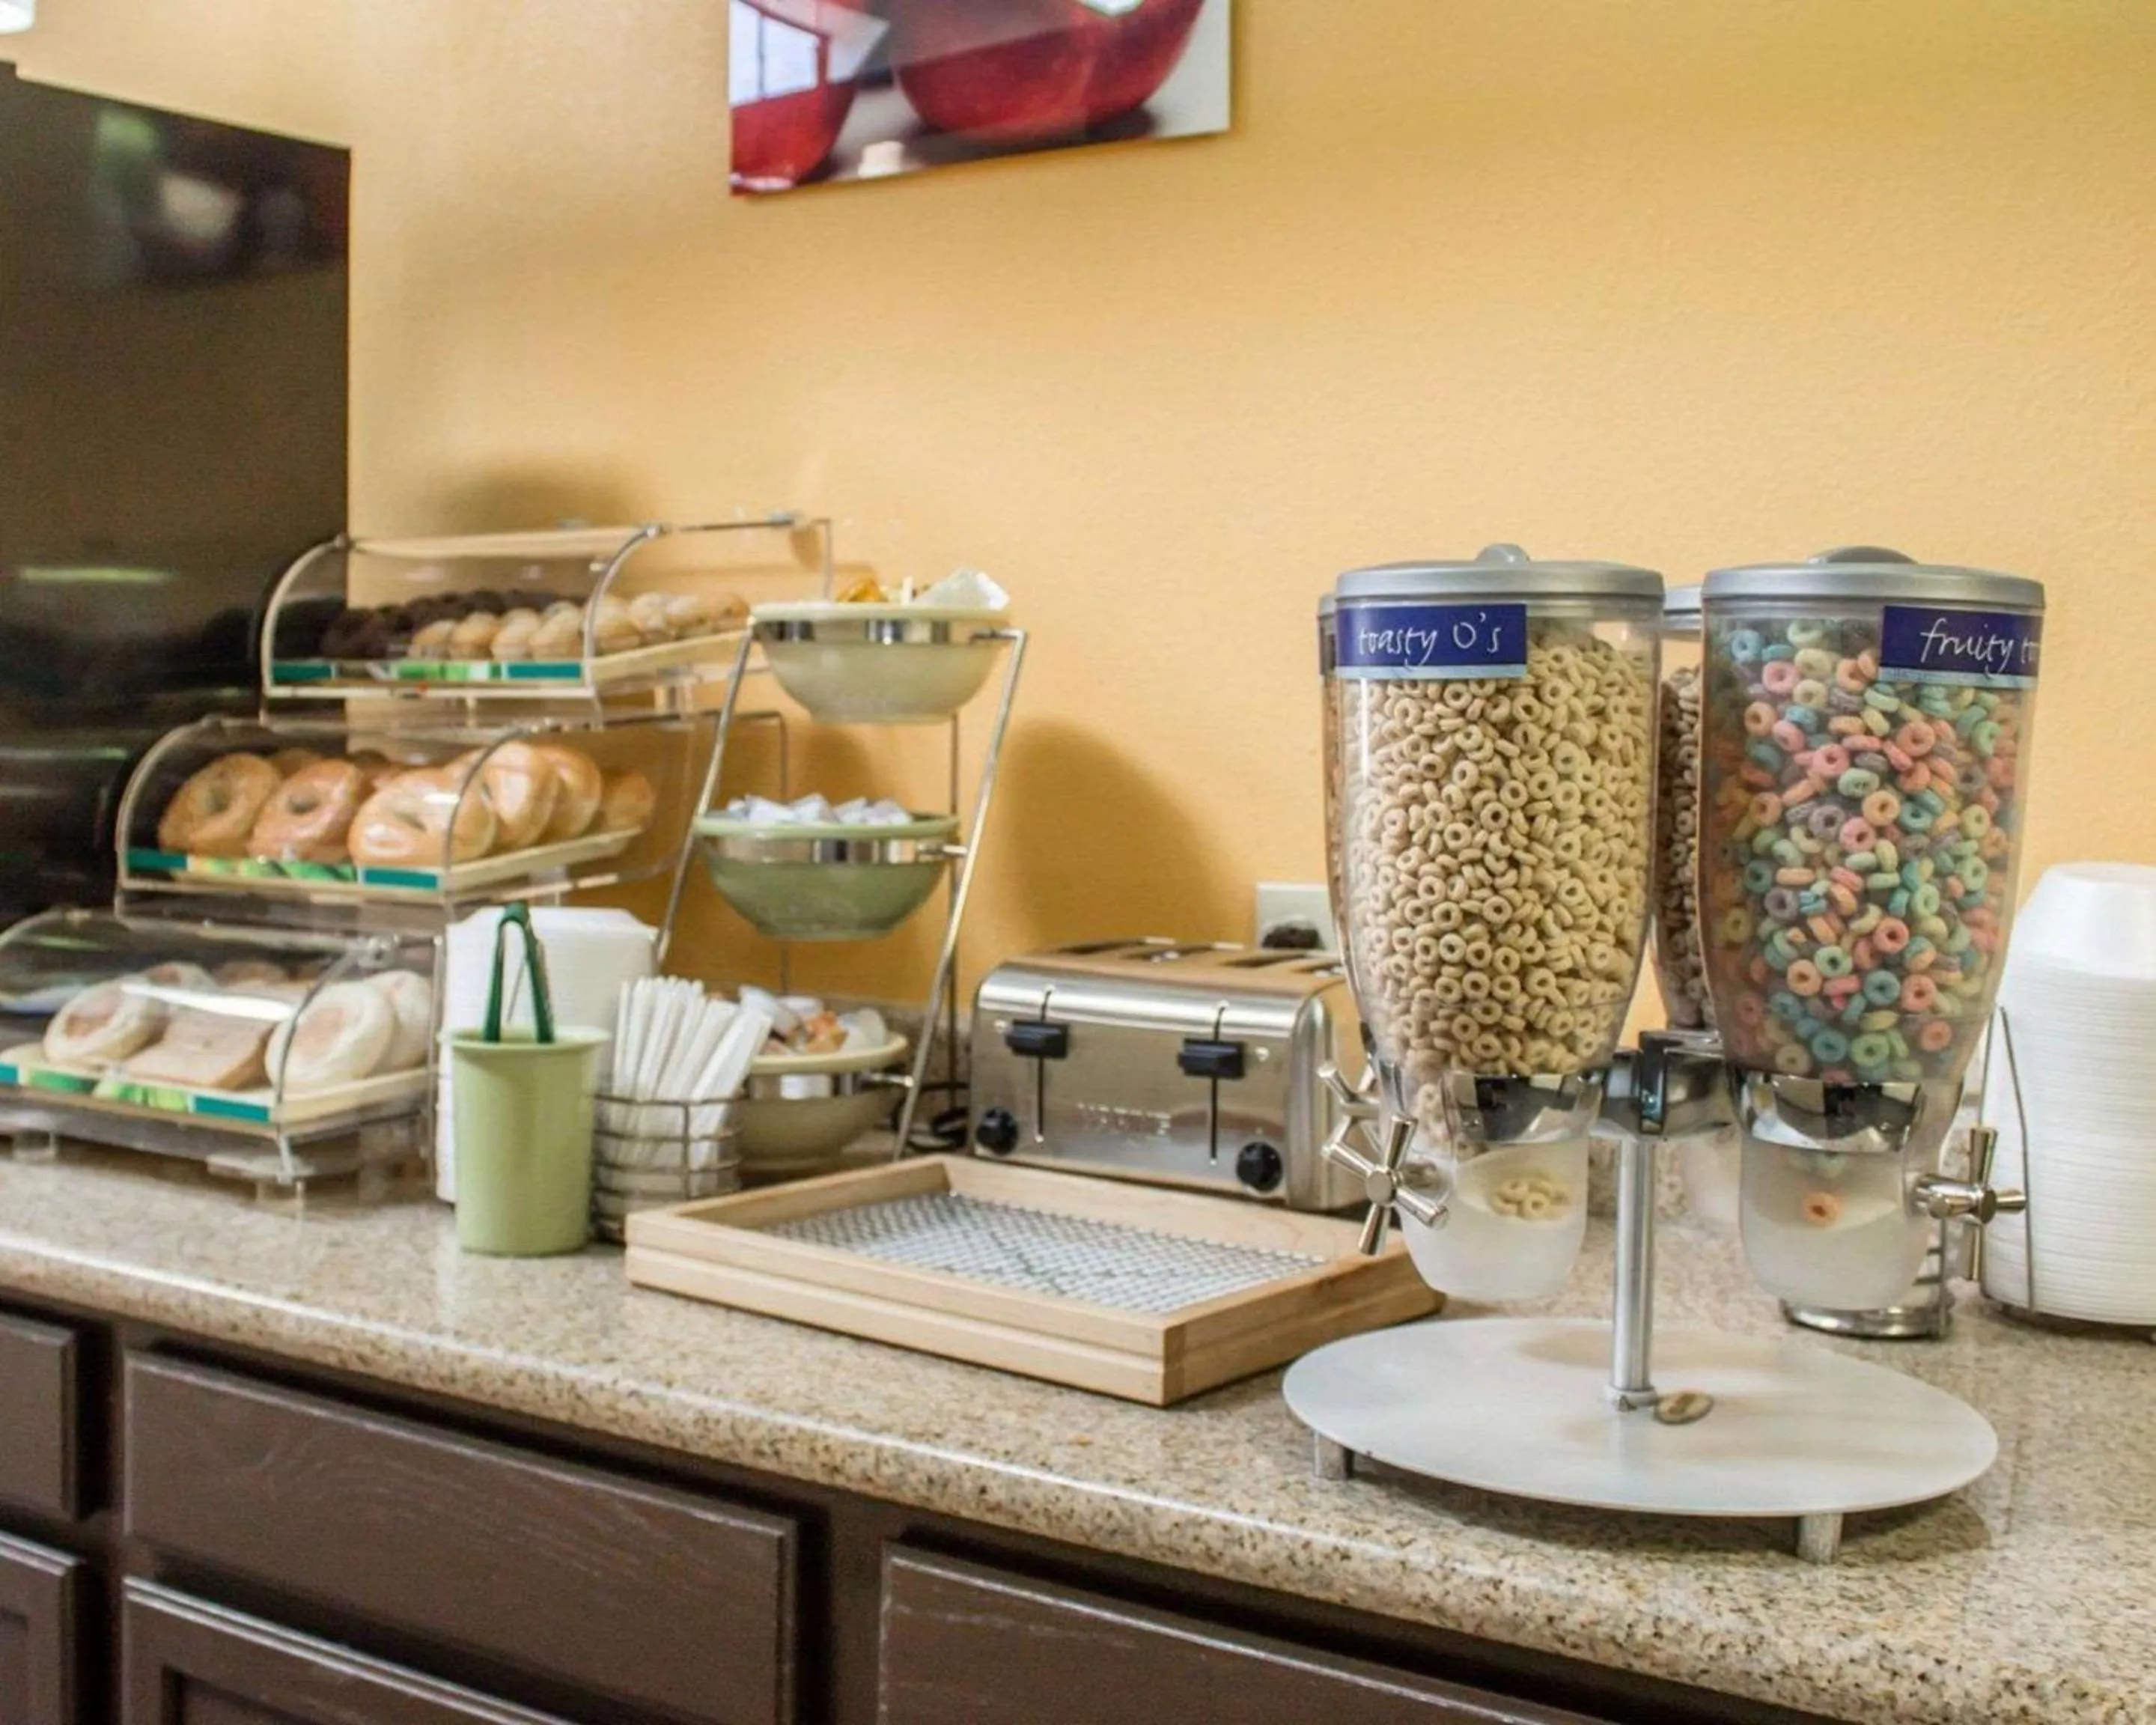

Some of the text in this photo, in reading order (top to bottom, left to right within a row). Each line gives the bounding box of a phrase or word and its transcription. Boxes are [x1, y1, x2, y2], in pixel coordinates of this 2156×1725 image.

[1359, 611, 1502, 672] toasty O's
[1919, 617, 2014, 679] fruity
